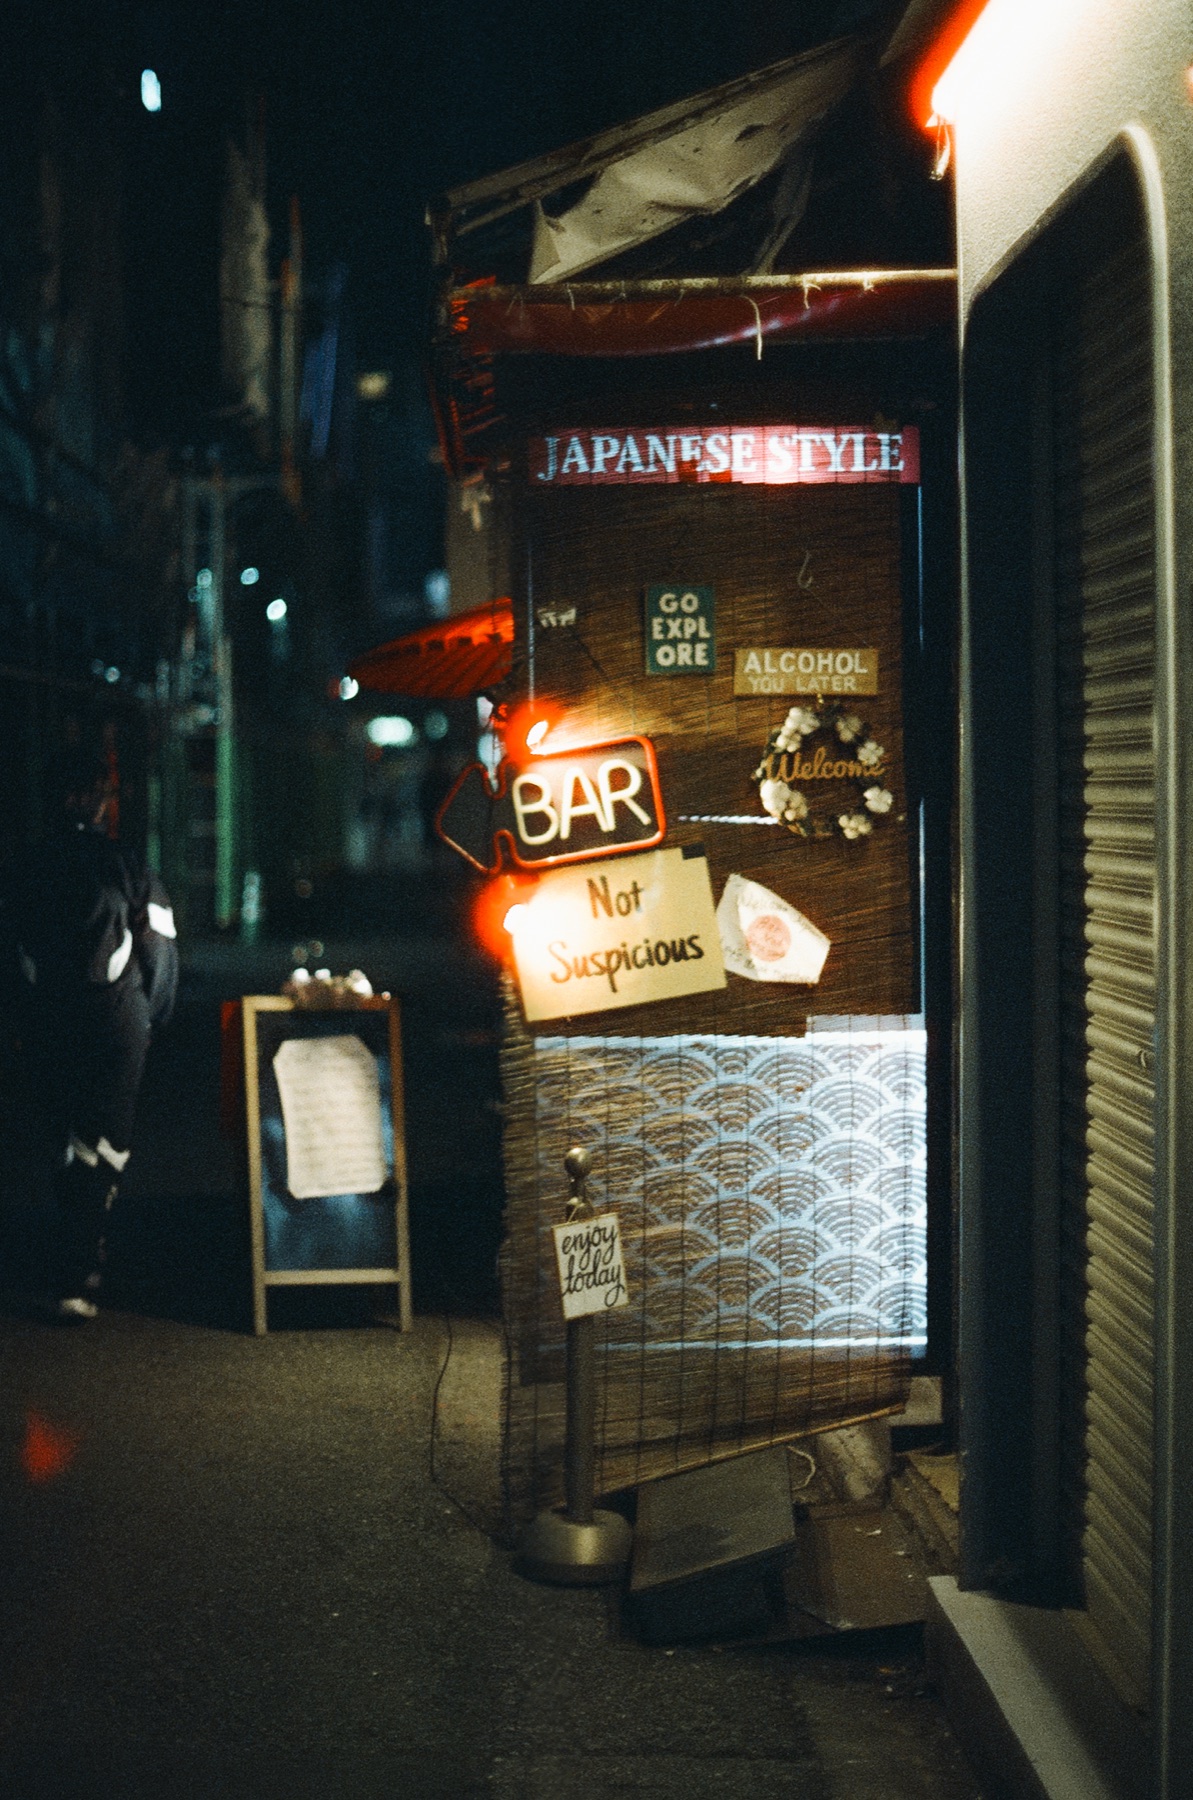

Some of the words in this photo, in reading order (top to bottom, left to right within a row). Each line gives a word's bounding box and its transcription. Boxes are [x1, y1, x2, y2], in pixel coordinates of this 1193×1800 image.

[537, 433, 757, 482] JAPANESE
[767, 432, 905, 473] STYLE
[659, 592, 699, 614] GO
[652, 616, 711, 640] EXPL
[656, 642, 709, 667] ORE
[743, 651, 868, 674] ALCOHOL
[749, 676, 784, 693] YOU
[796, 675, 857, 693] LATER
[764, 746, 888, 782] Welcome
[512, 759, 652, 846] BAR
[587, 876, 644, 918] Not
[548, 935, 704, 993] Suspicious
[562, 1225, 617, 1271] enjoy
[562, 1249, 625, 1307] today
